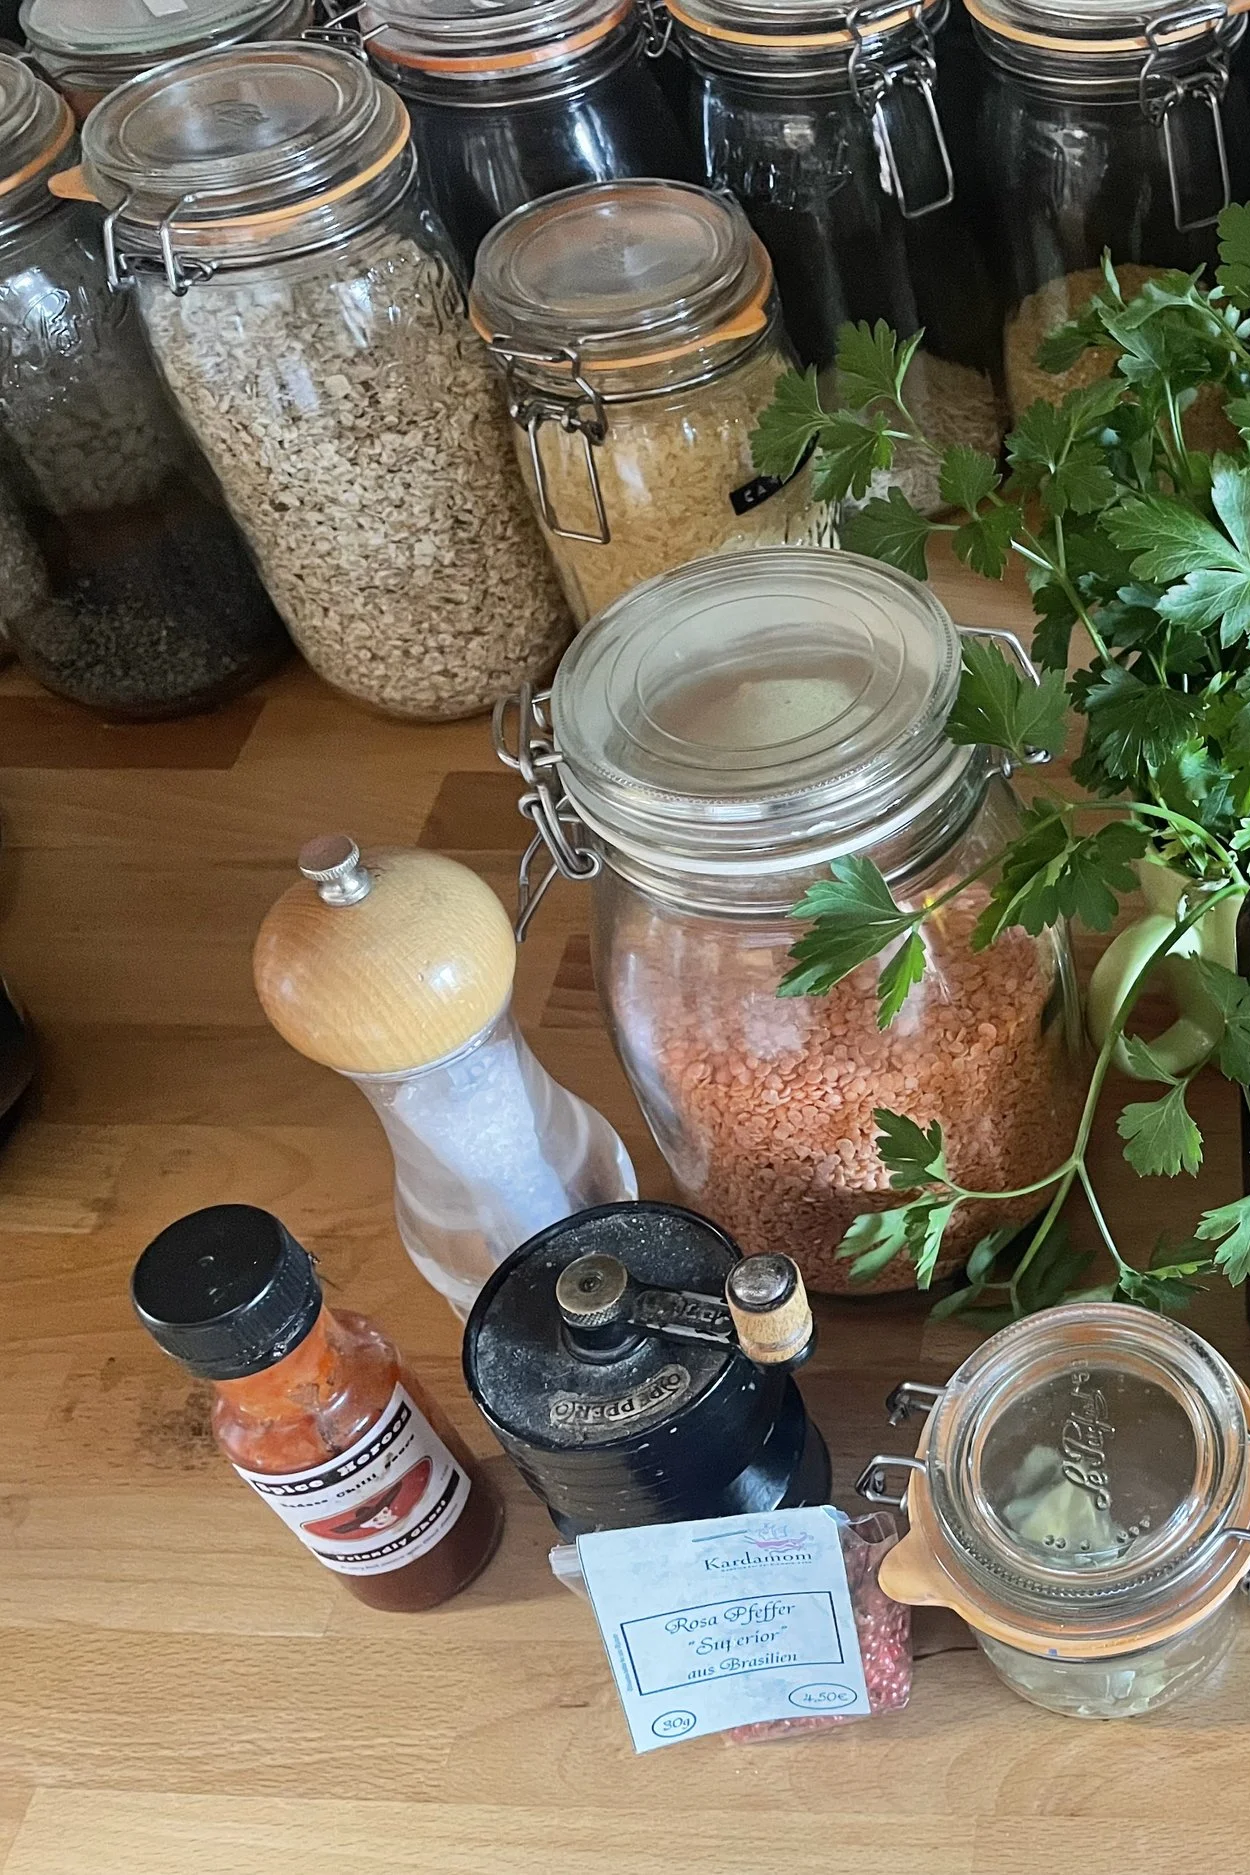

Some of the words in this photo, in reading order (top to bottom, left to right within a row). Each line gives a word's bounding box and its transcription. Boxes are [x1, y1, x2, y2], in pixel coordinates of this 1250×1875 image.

[576, 1384, 665, 1420] PEPPER
[255, 1478, 325, 1497] Spice
[336, 1538, 408, 1561] Friendly
[704, 1550, 813, 1572] Kardamom
[664, 1613, 719, 1635] Rosa
[723, 1601, 796, 1627] Pfeffer
[687, 1664, 715, 1681] aus
[719, 1651, 798, 1672] Brasilien
